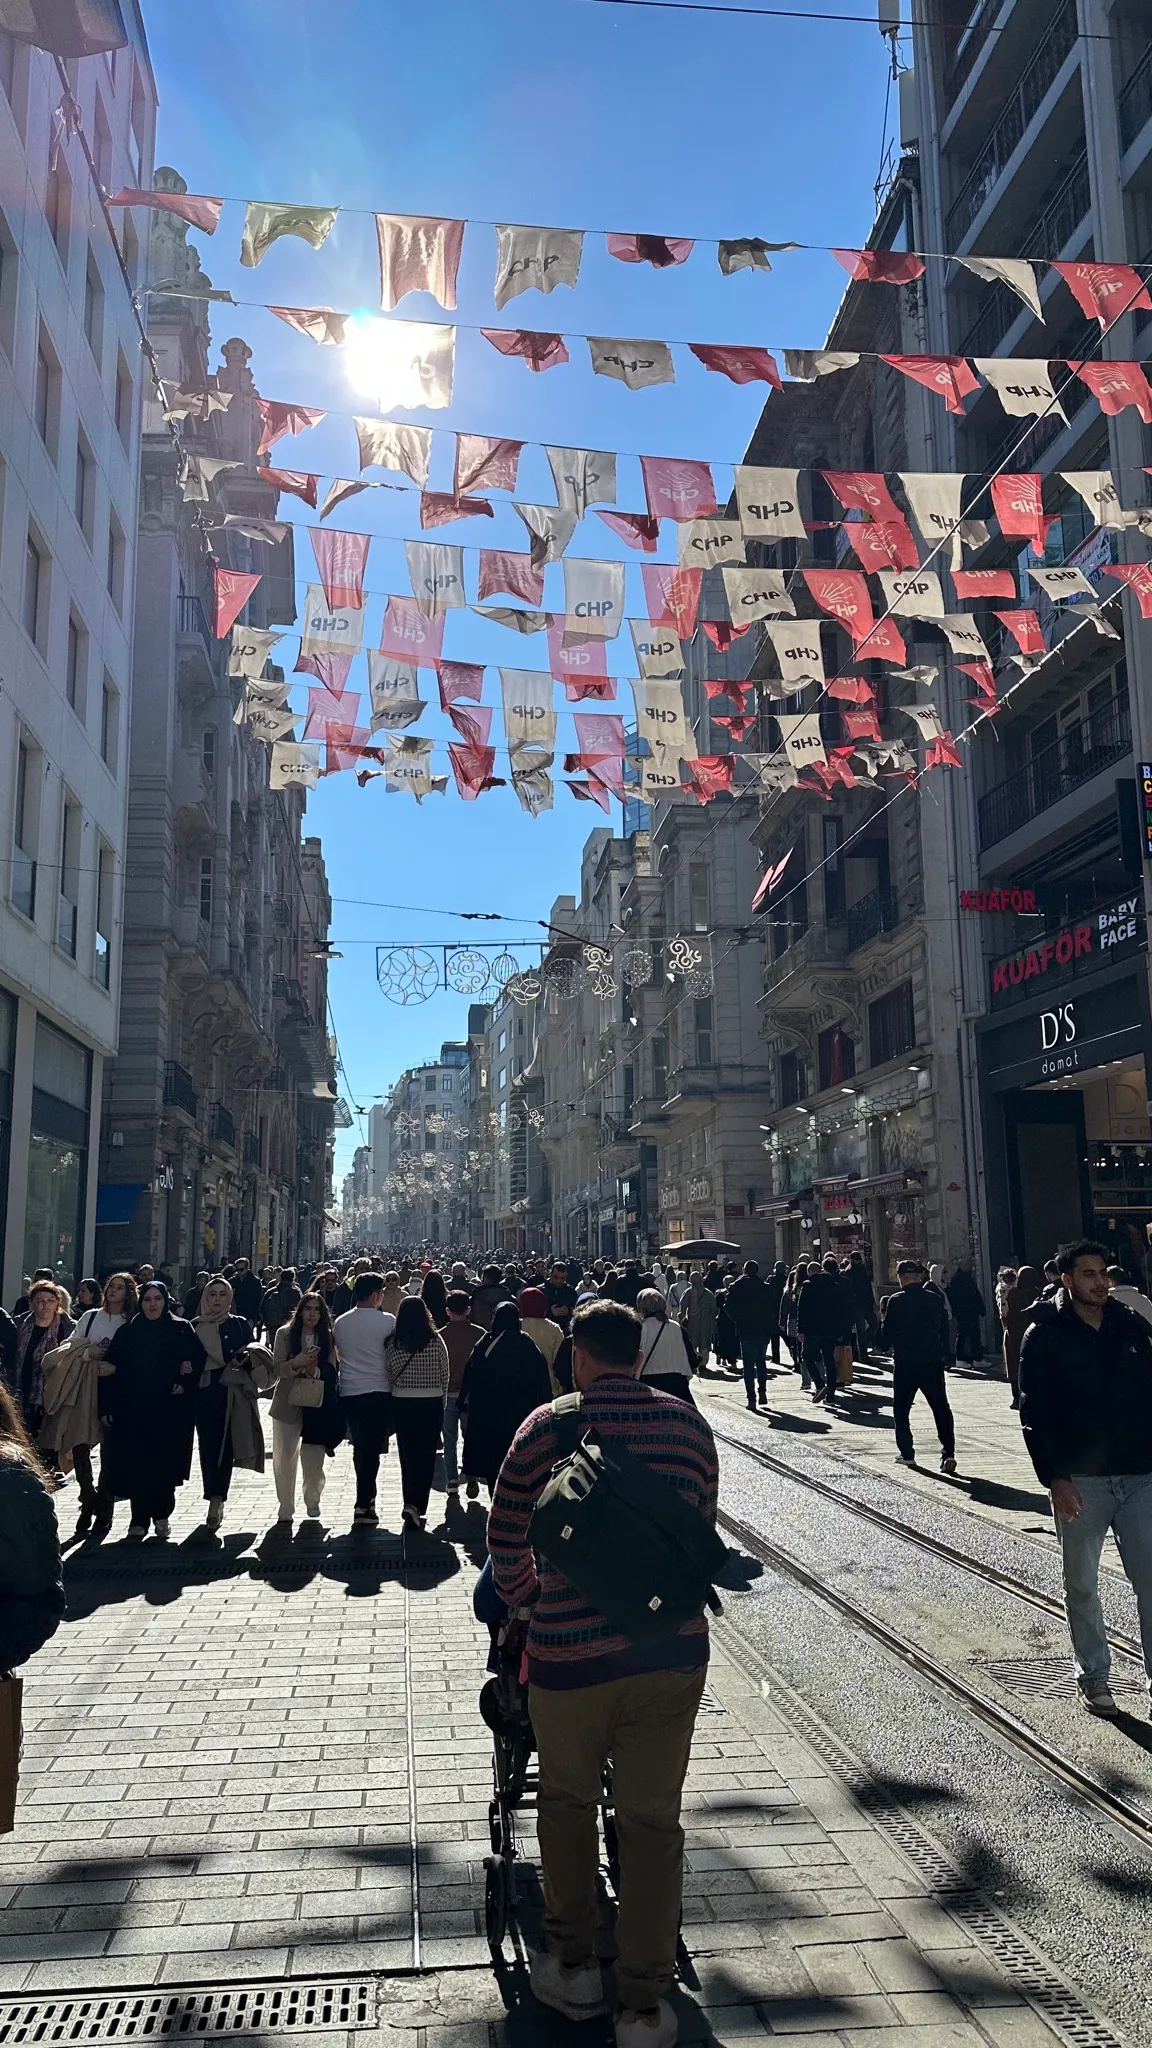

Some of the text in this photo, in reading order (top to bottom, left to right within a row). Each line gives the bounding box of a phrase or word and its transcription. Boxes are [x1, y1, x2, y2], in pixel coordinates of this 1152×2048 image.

[508, 254, 559, 276] CHP
[691, 535, 733, 551] CHP
[964, 570, 999, 580] CHP
[1045, 571, 1078, 582] CHP
[741, 590, 781, 606] CHP
[893, 582, 929, 596] CHP
[574, 600, 614, 618] CHP
[661, 599, 685, 619] CHP
[394, 769, 423, 779] CHP
[960, 889, 1036, 911] KUAFÖR
[1099, 897, 1138, 930] BABY
[1100, 920, 1138, 949] FACE
[992, 924, 1092, 993] KUAFÖR
[1041, 1050, 1079, 1074] damat
[686, 1176, 711, 1202] DeFacto
